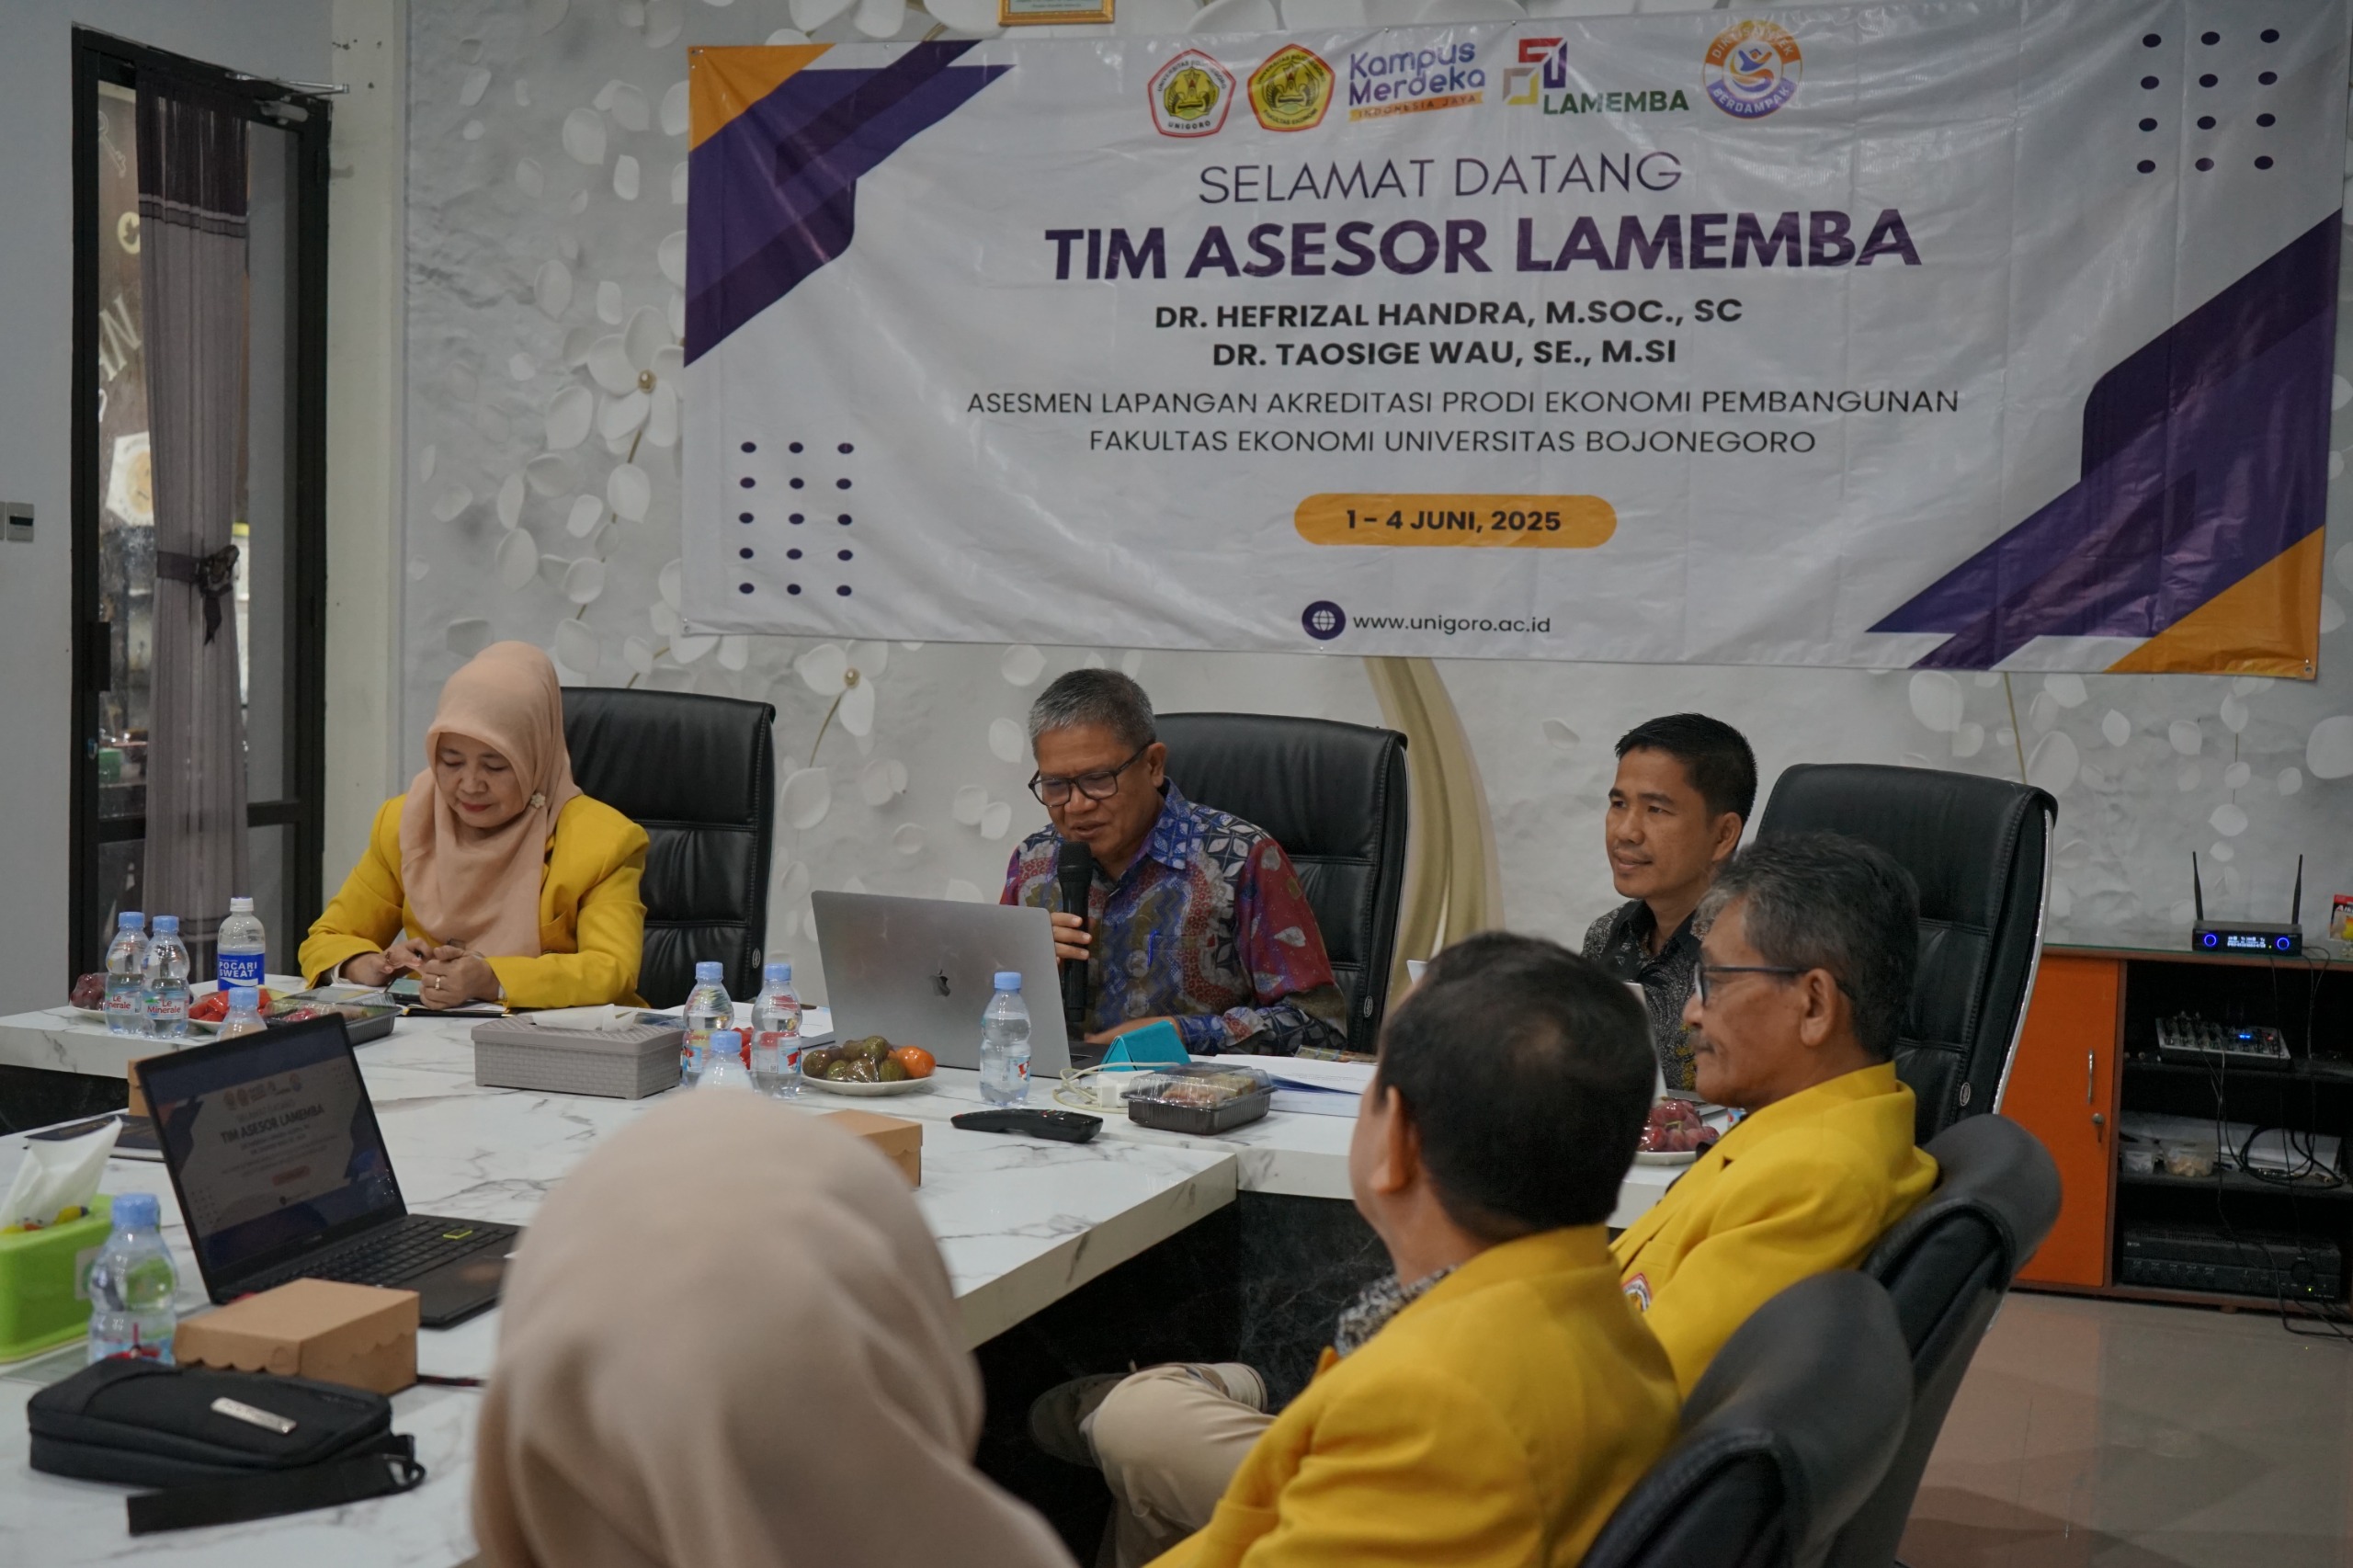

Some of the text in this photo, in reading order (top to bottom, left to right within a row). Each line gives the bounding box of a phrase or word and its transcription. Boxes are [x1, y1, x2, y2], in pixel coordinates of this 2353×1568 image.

[1256, 54, 1325, 85] UNIVERSITAS BOJEGORO
[1349, 41, 1476, 81] Kampus
[1157, 60, 1227, 92] UNIVERSITAS BOJEGORO
[1348, 65, 1485, 106] Merdeka
[1358, 95, 1476, 119] INDONESIA JAYA
[1543, 89, 1690, 115] LAMEMBA
[1712, 85, 1790, 113] BERDAMPAK
[1168, 119, 1211, 131] UNIGORO
[1199, 151, 1682, 204] SELAMAT DATANG
[1045, 209, 1923, 280] TIM ASESOR LAMEMBA
[1155, 299, 1743, 328] DR. HEFRIZAL HANDRA, M.SOC., SC
[1213, 340, 1676, 368] DR. TAOSIGE WAU, SE., M.SI
[968, 391, 1958, 414] ASESMEN LAPANGAN AKREDITASI PRODI EKONOMI PEMBANGUNAN
[1091, 430, 1815, 453] FAKULTAS EKONOMI UNIVERSITAS BOJONEGORO
[1347, 510, 1356, 529] 1
[1385, 510, 1404, 530] 4
[1411, 511, 1483, 534] JUNI,
[1491, 511, 1562, 531] 2025
[1353, 614, 1551, 636] www.unigoro.ac.id
[219, 961, 257, 970] POCARI
[220, 970, 255, 978] SWEAT
[106, 1001, 131, 1009] inerale
[147, 1006, 181, 1014] Minerale
[162, 999, 172, 1007] Le
[241, 1117, 279, 1138] ASESOR
